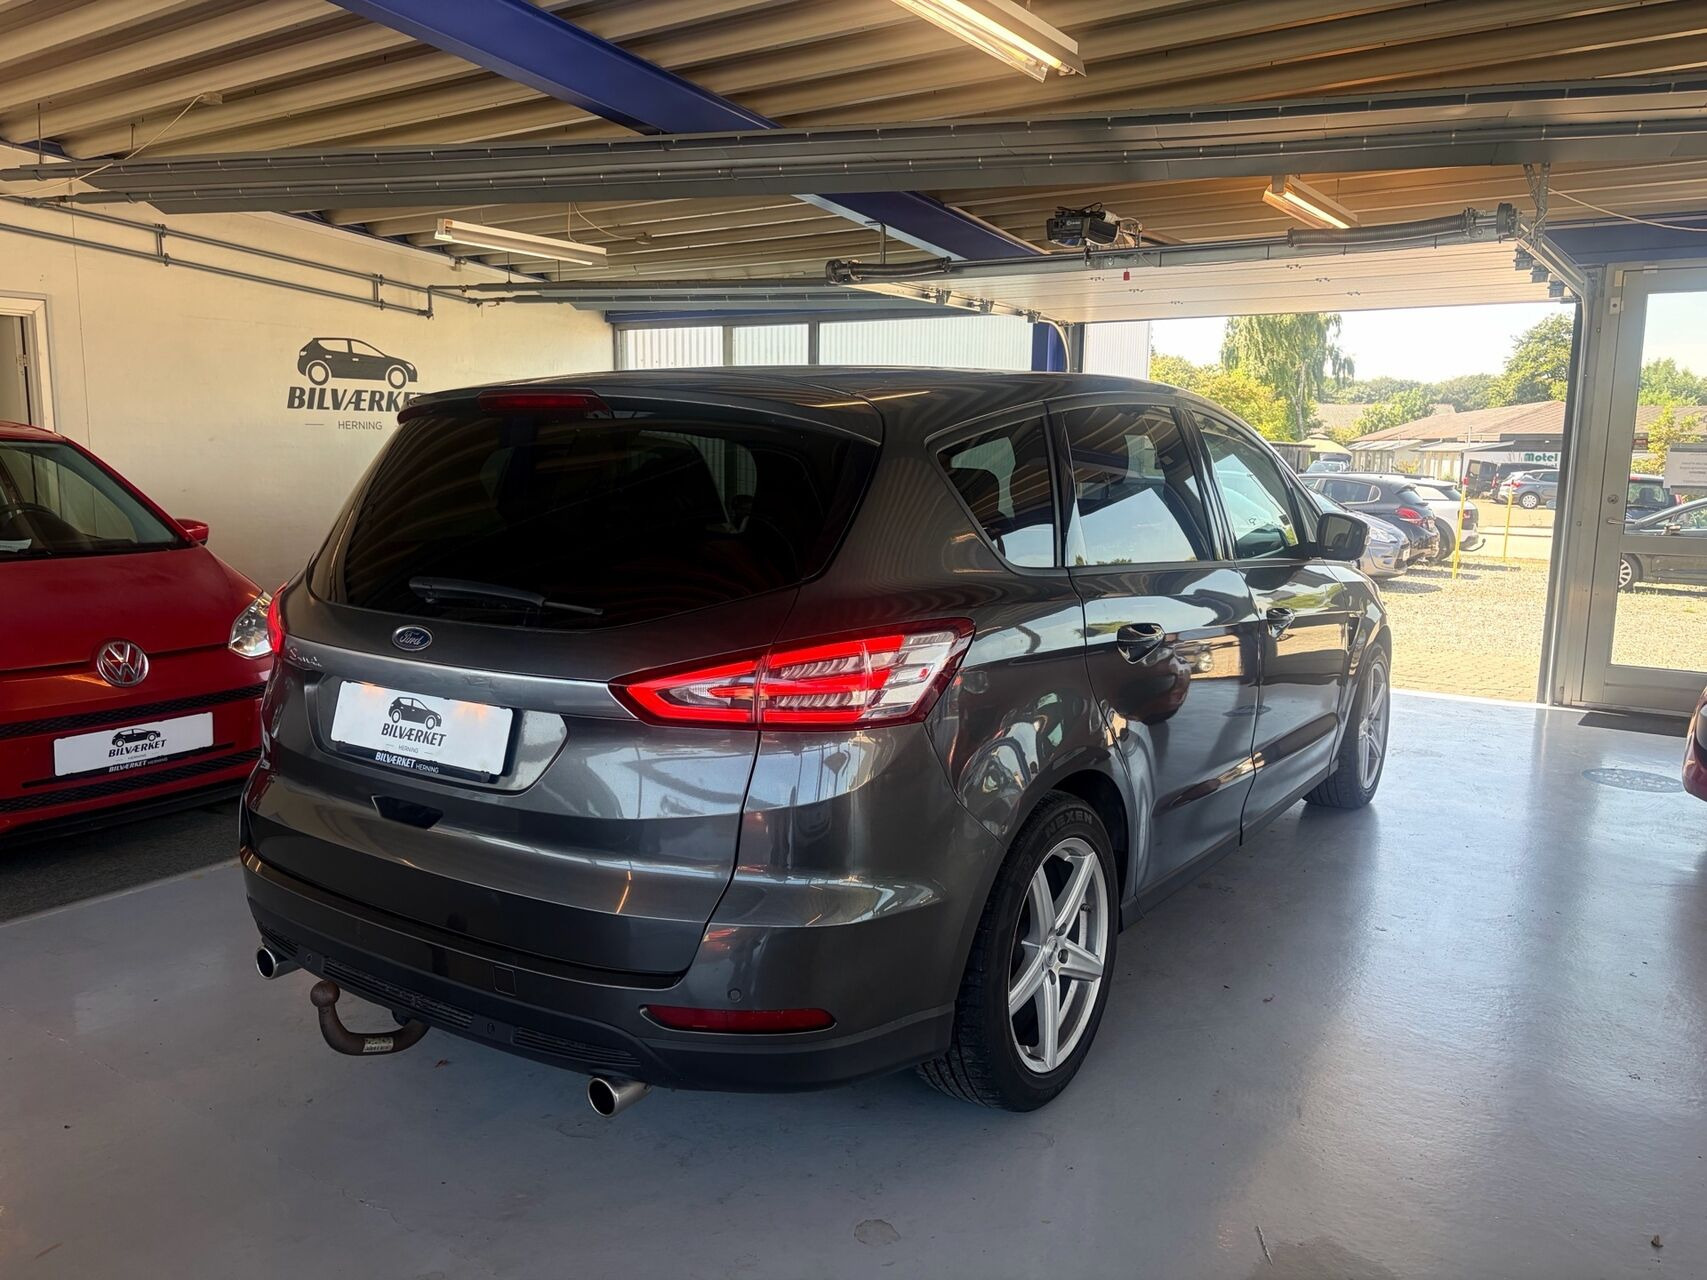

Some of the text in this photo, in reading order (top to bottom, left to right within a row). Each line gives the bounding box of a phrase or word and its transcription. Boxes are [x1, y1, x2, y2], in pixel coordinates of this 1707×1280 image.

[287, 386, 425, 412] BILVÆRK
[338, 421, 383, 430] HERNING
[1524, 453, 1558, 462] Motel
[399, 630, 424, 645] Ford
[381, 723, 447, 747] BILVÆRKET
[108, 739, 167, 758] BILVÆRKET
[375, 751, 439, 774] BILVÆRKET HERNING
[1044, 810, 1092, 837] NEXEN
